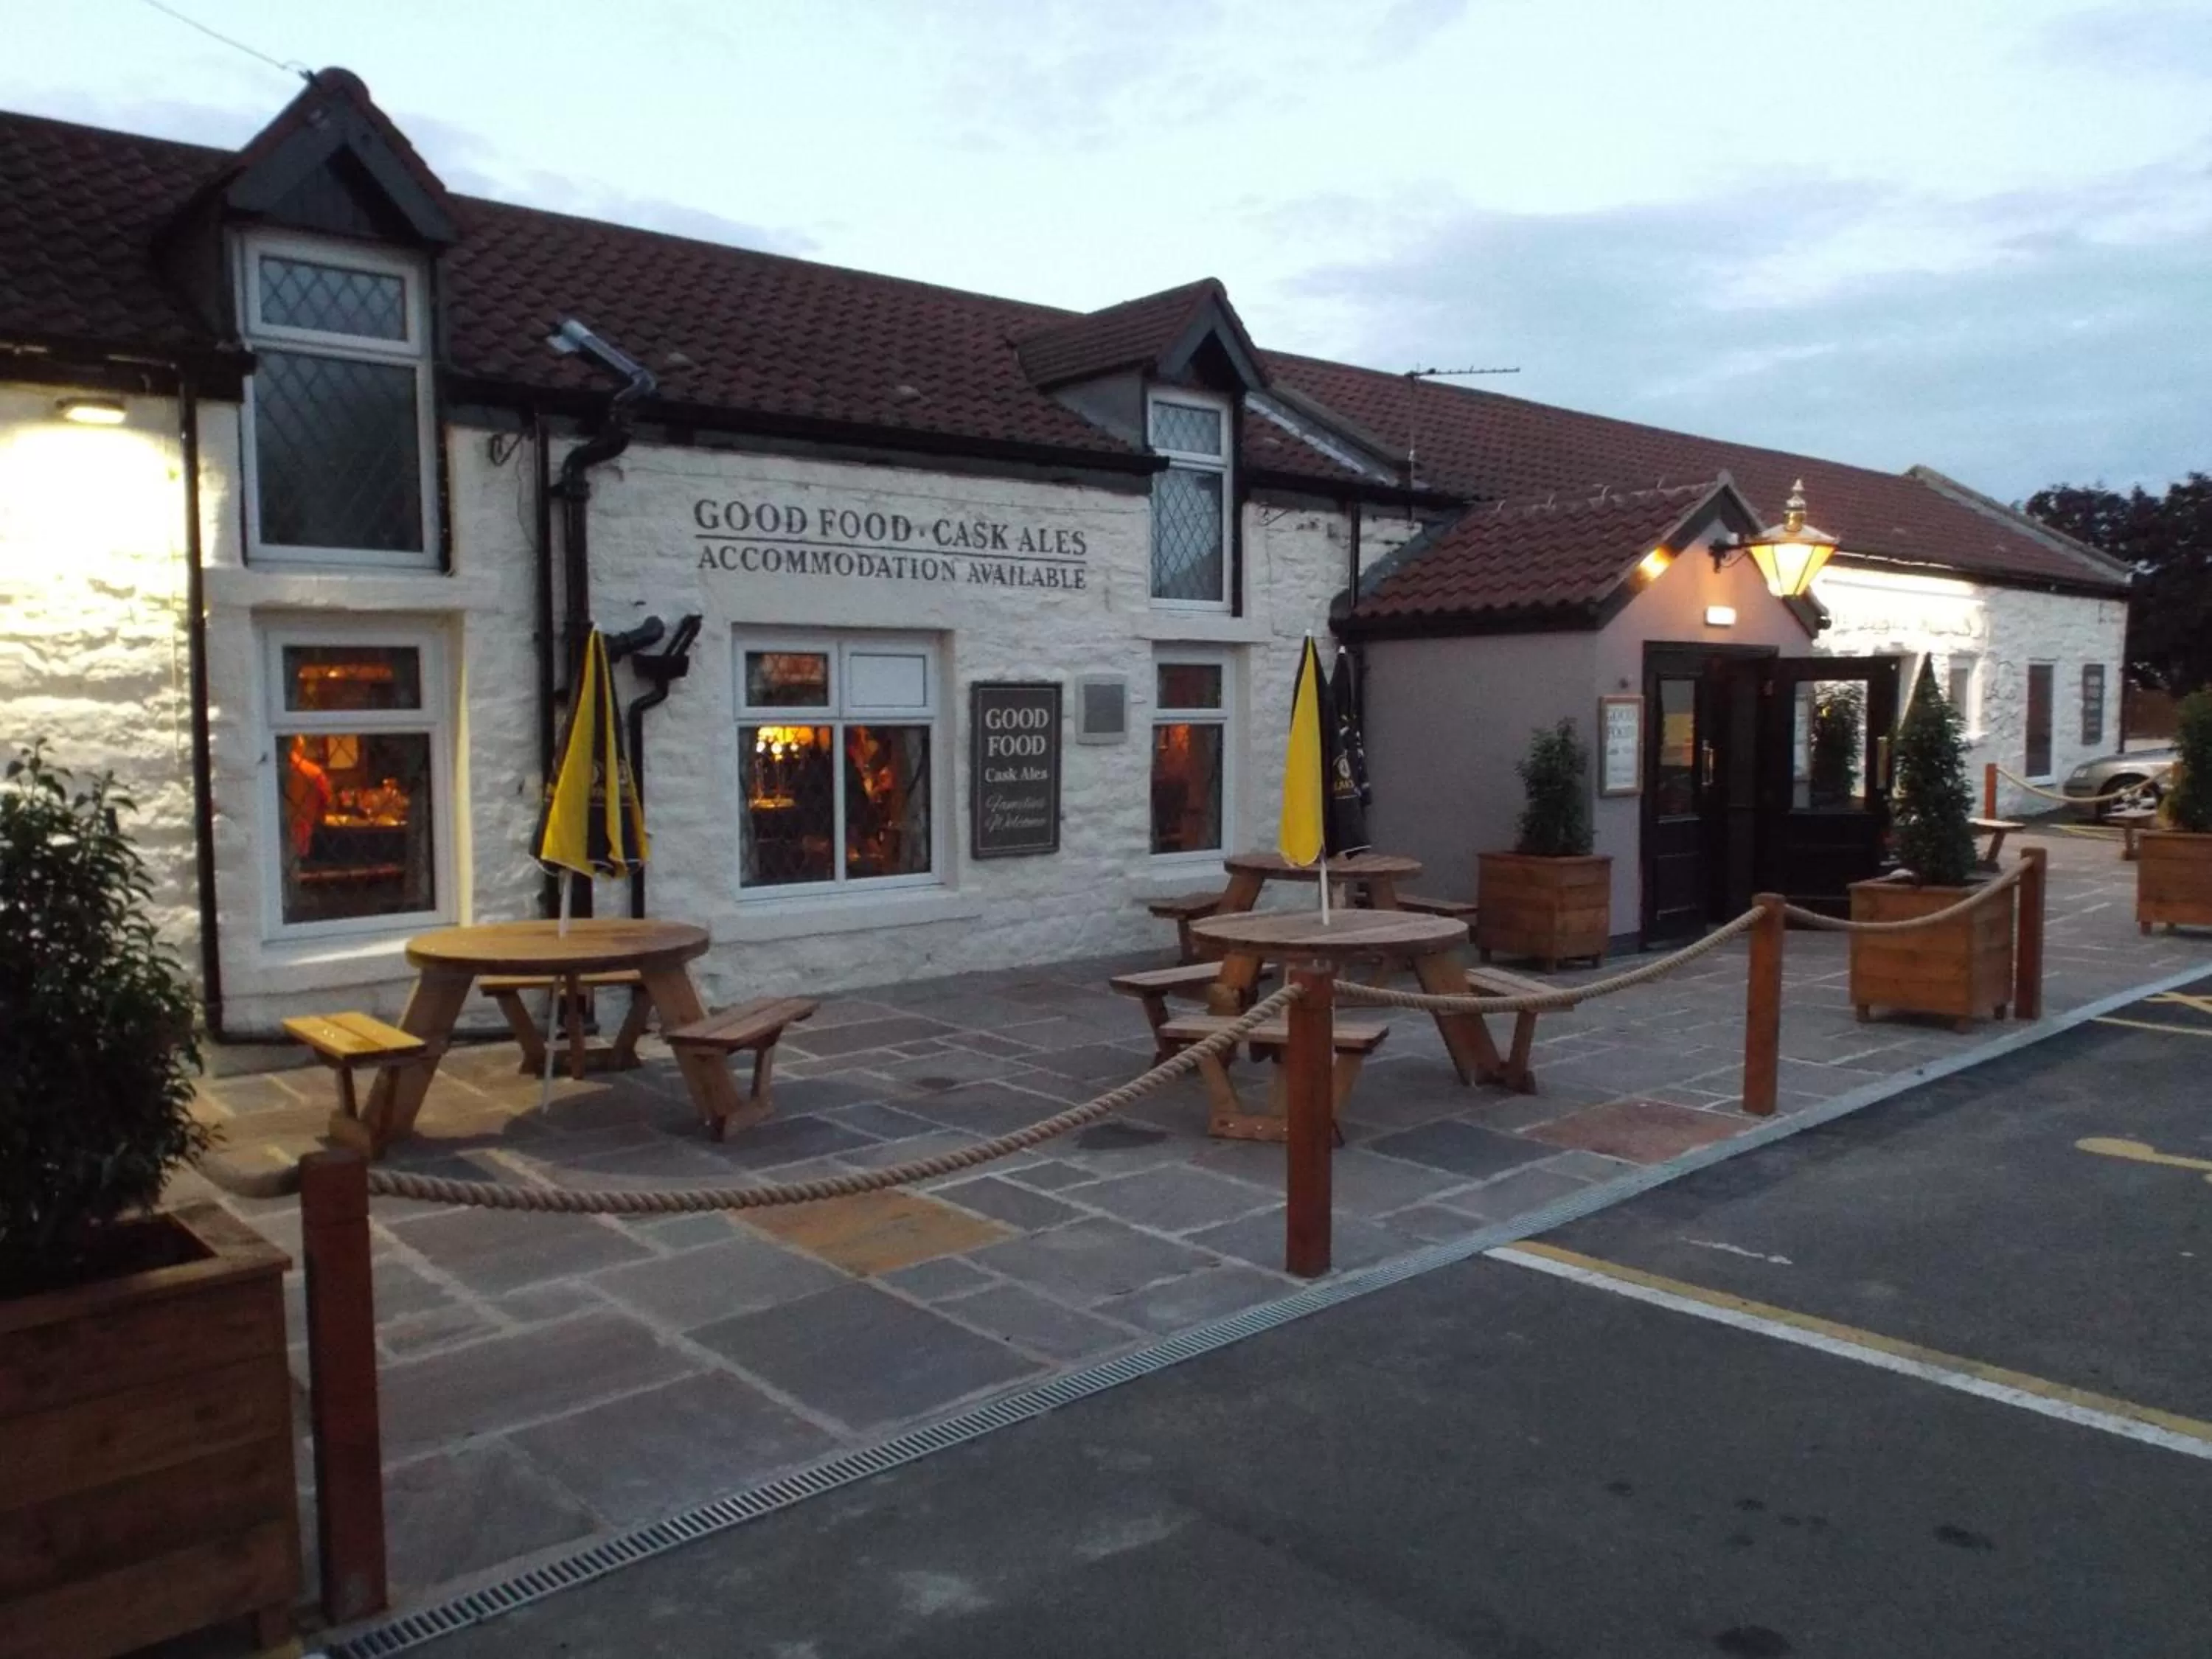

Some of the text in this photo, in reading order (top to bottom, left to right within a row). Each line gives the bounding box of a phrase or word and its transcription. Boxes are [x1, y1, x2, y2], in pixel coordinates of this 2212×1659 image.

[694, 498, 1087, 556] GOOD FOOD CASK ALES
[697, 545, 1086, 590] ACCOMMODATION AVAILABLE
[984, 708, 1049, 729] GOOD
[987, 734, 1046, 757] FOOD
